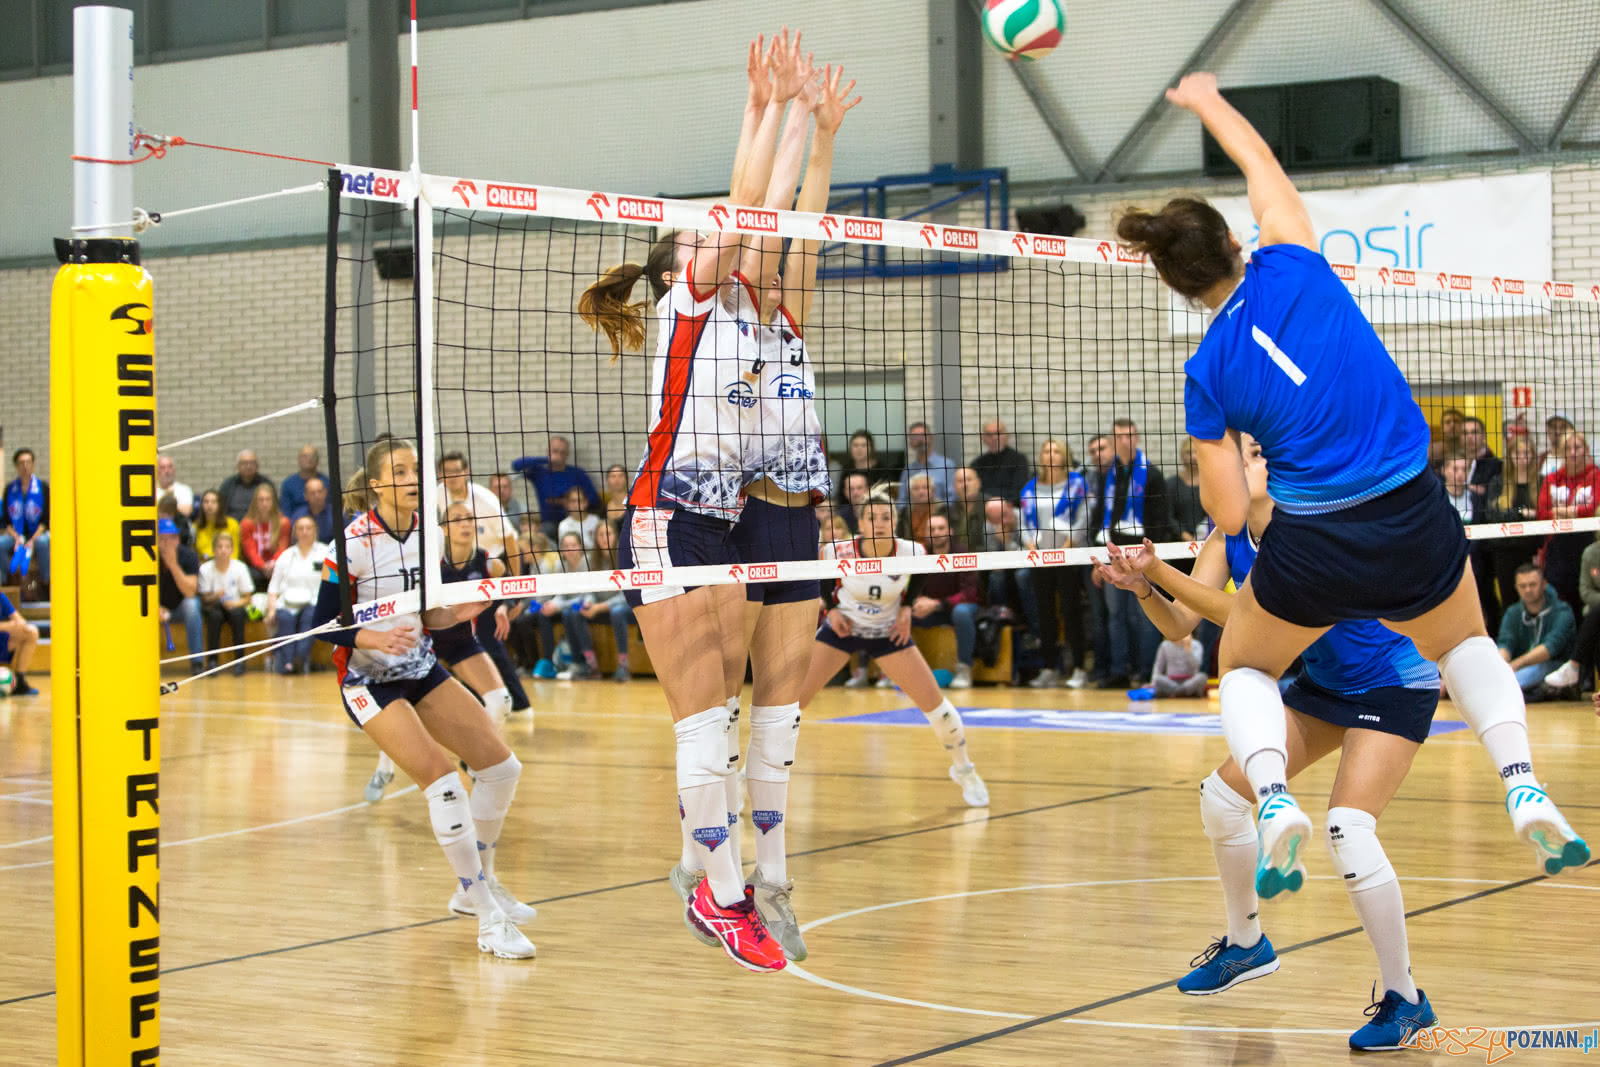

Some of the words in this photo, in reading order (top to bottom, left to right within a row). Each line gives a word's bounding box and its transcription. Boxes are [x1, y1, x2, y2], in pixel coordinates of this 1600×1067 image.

[340, 172, 400, 198] netex
[488, 186, 536, 208] ORLEN
[618, 200, 662, 220] ORLEN
[737, 211, 777, 230] ORLEN
[846, 221, 881, 238] ORLEN
[944, 231, 977, 247] ORLEN
[1034, 239, 1064, 254] ORLEN
[1252, 325, 1307, 387] 1
[117, 354, 157, 617] SPORT
[953, 555, 976, 568] ORLEN
[1042, 551, 1064, 563] ORLEN
[749, 566, 777, 579] ORLEN
[855, 561, 881, 573] ORLEN
[632, 571, 662, 585] ORLEN
[502, 579, 535, 594] ORLEN
[869, 585, 882, 600] 9
[354, 600, 396, 624] netex
[352, 695, 369, 711] 16
